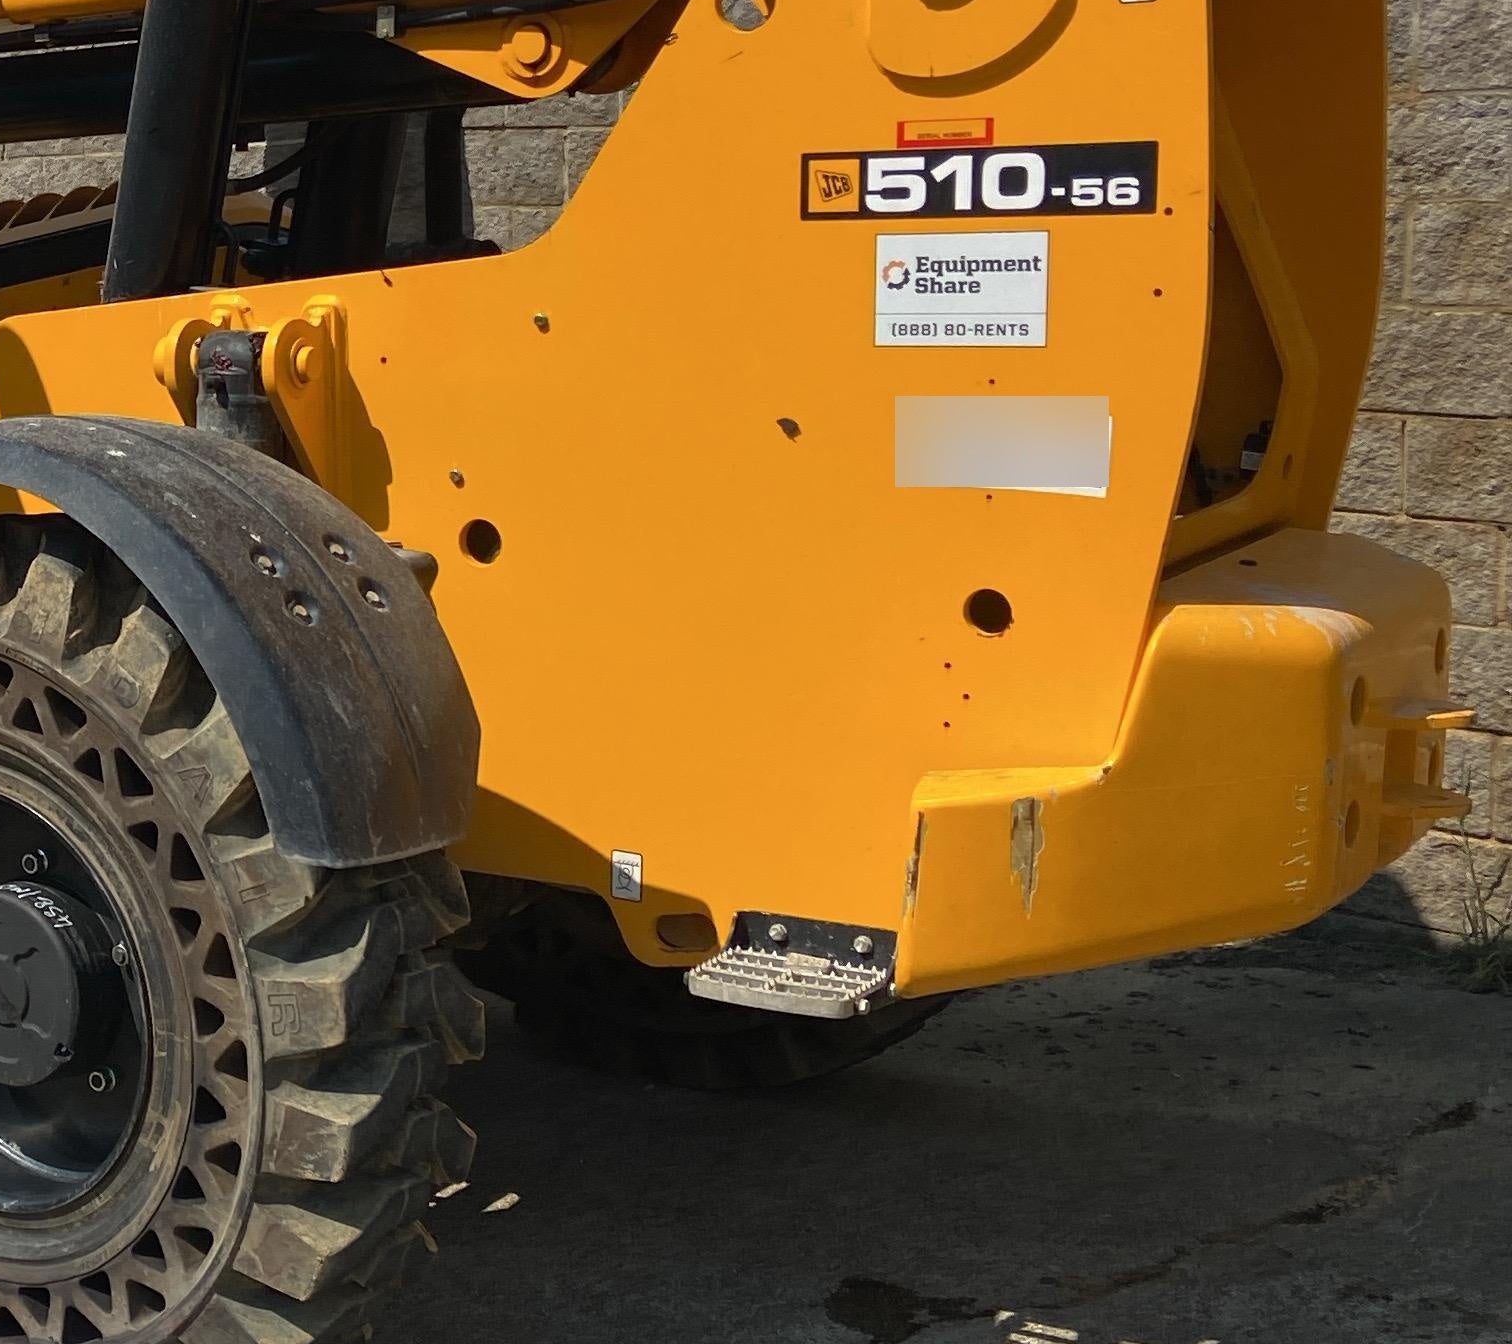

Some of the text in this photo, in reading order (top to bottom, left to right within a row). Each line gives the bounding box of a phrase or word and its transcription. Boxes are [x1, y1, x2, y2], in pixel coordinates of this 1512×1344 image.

[821, 152, 1140, 213] JCB 510-56
[915, 256, 1042, 278] Equipment
[915, 277, 981, 294] Share
[891, 322, 1030, 338] (888) 80-RENTS
